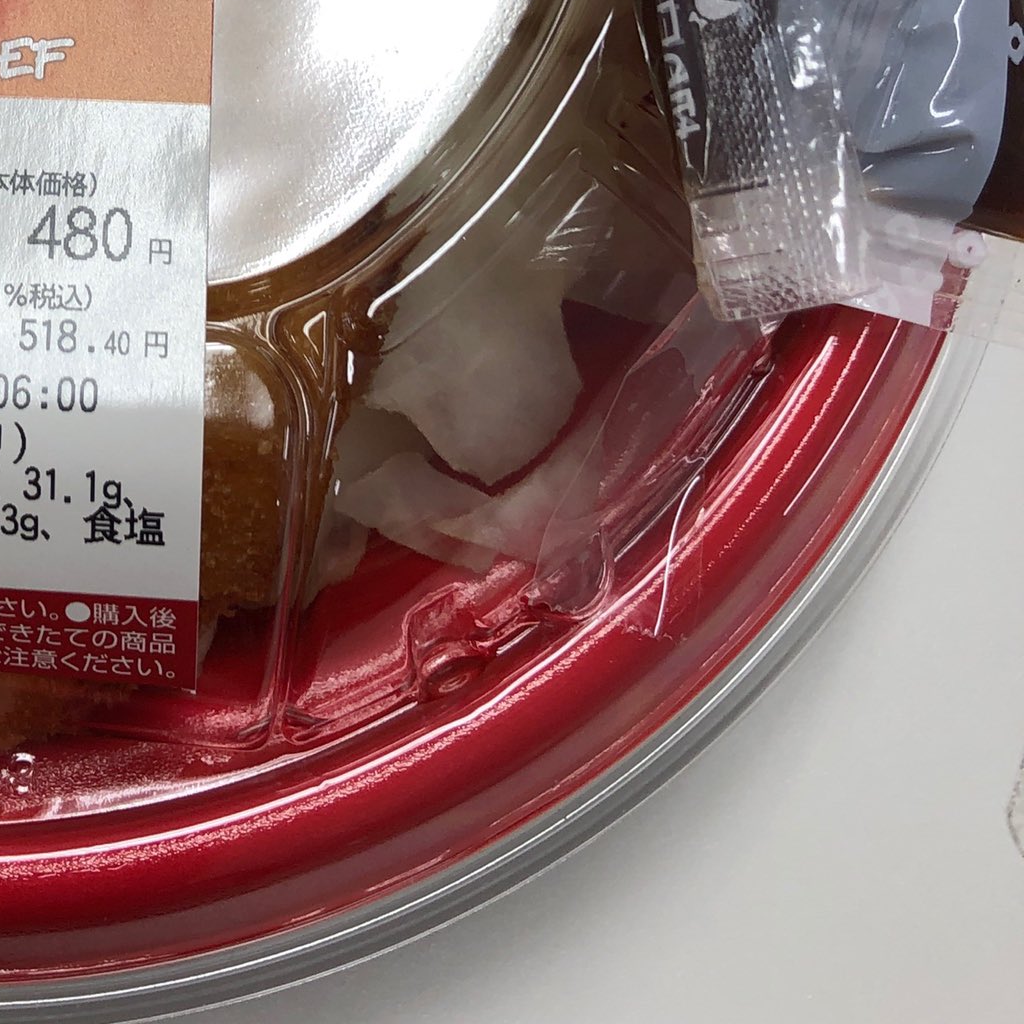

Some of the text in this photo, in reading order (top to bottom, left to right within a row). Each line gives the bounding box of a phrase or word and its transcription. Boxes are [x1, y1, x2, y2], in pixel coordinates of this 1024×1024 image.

[27, 204, 173, 265] 480 円
[144, 331, 169, 359] 円
